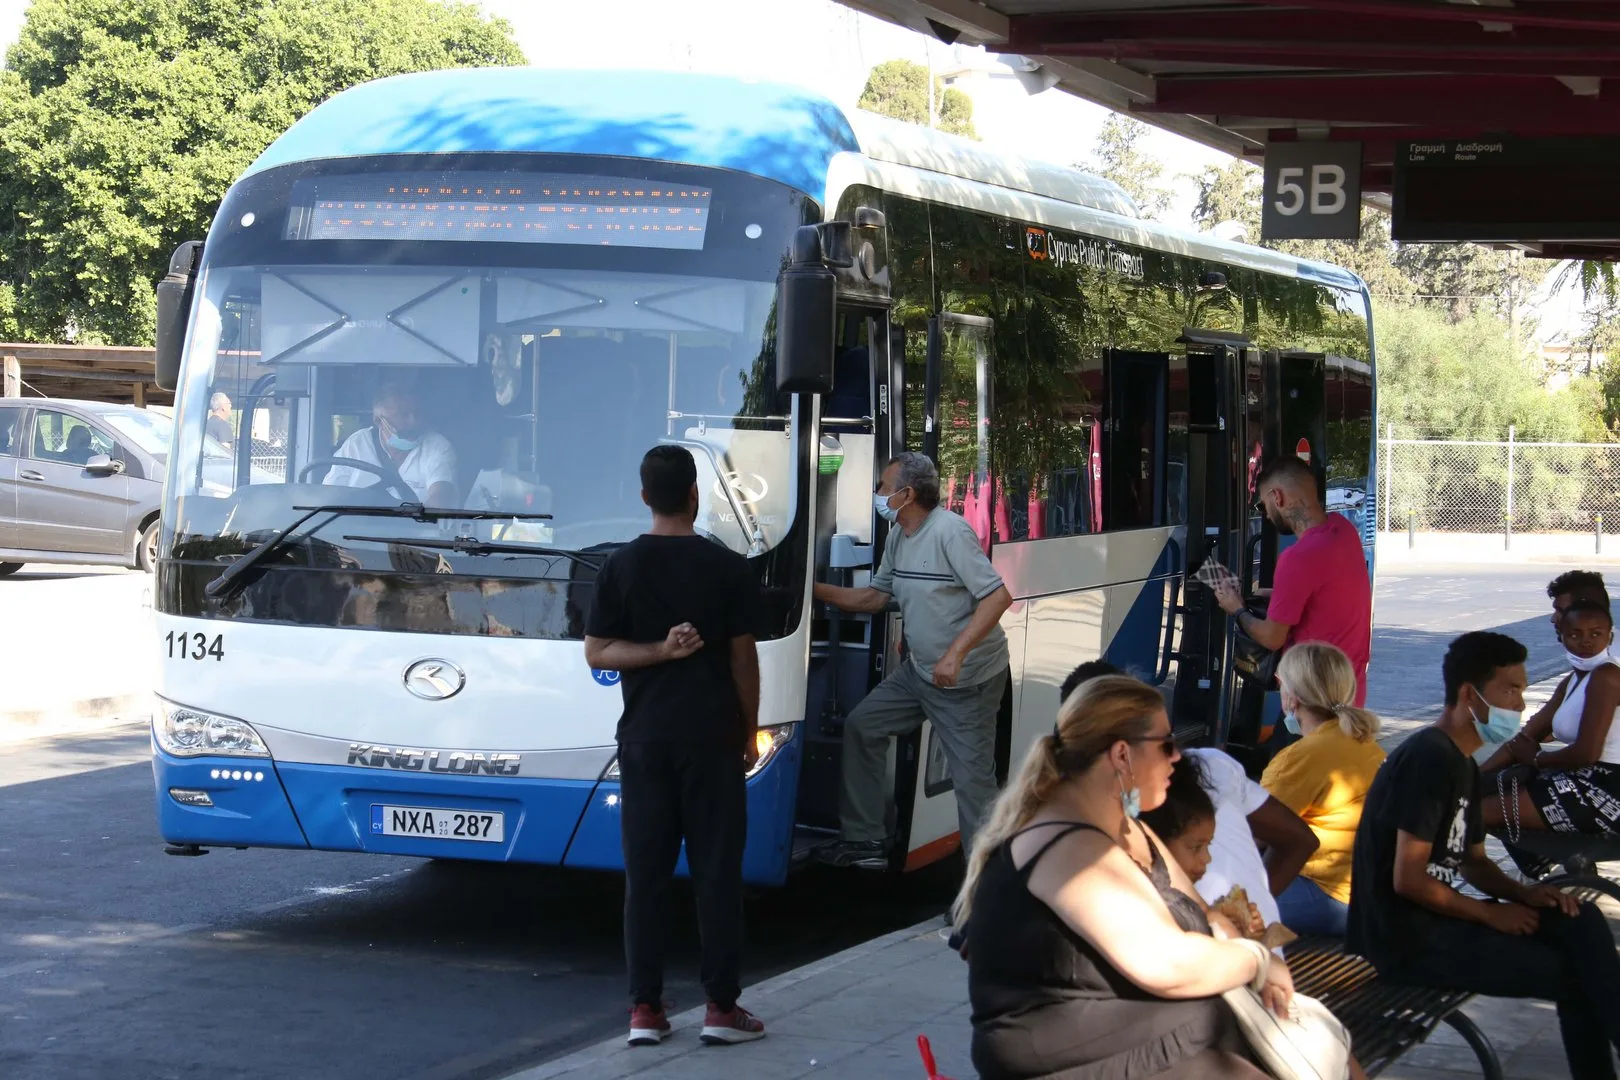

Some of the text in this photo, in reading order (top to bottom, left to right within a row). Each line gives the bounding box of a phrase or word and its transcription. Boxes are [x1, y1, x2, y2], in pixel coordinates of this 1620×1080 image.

[1409, 142, 1503, 154] Γραμμή Διαδρομή
[1409, 153, 1477, 161] Line Route
[1274, 164, 1347, 216] 5B
[1047, 231, 1079, 269] Cyprus
[1078, 238, 1106, 270] Public
[1105, 244, 1145, 279] Transport
[165, 630, 225, 662] 1134
[347, 743, 521, 776] KING LONG
[372, 822, 383, 830] CY
[392, 809, 494, 838] NXA 287
